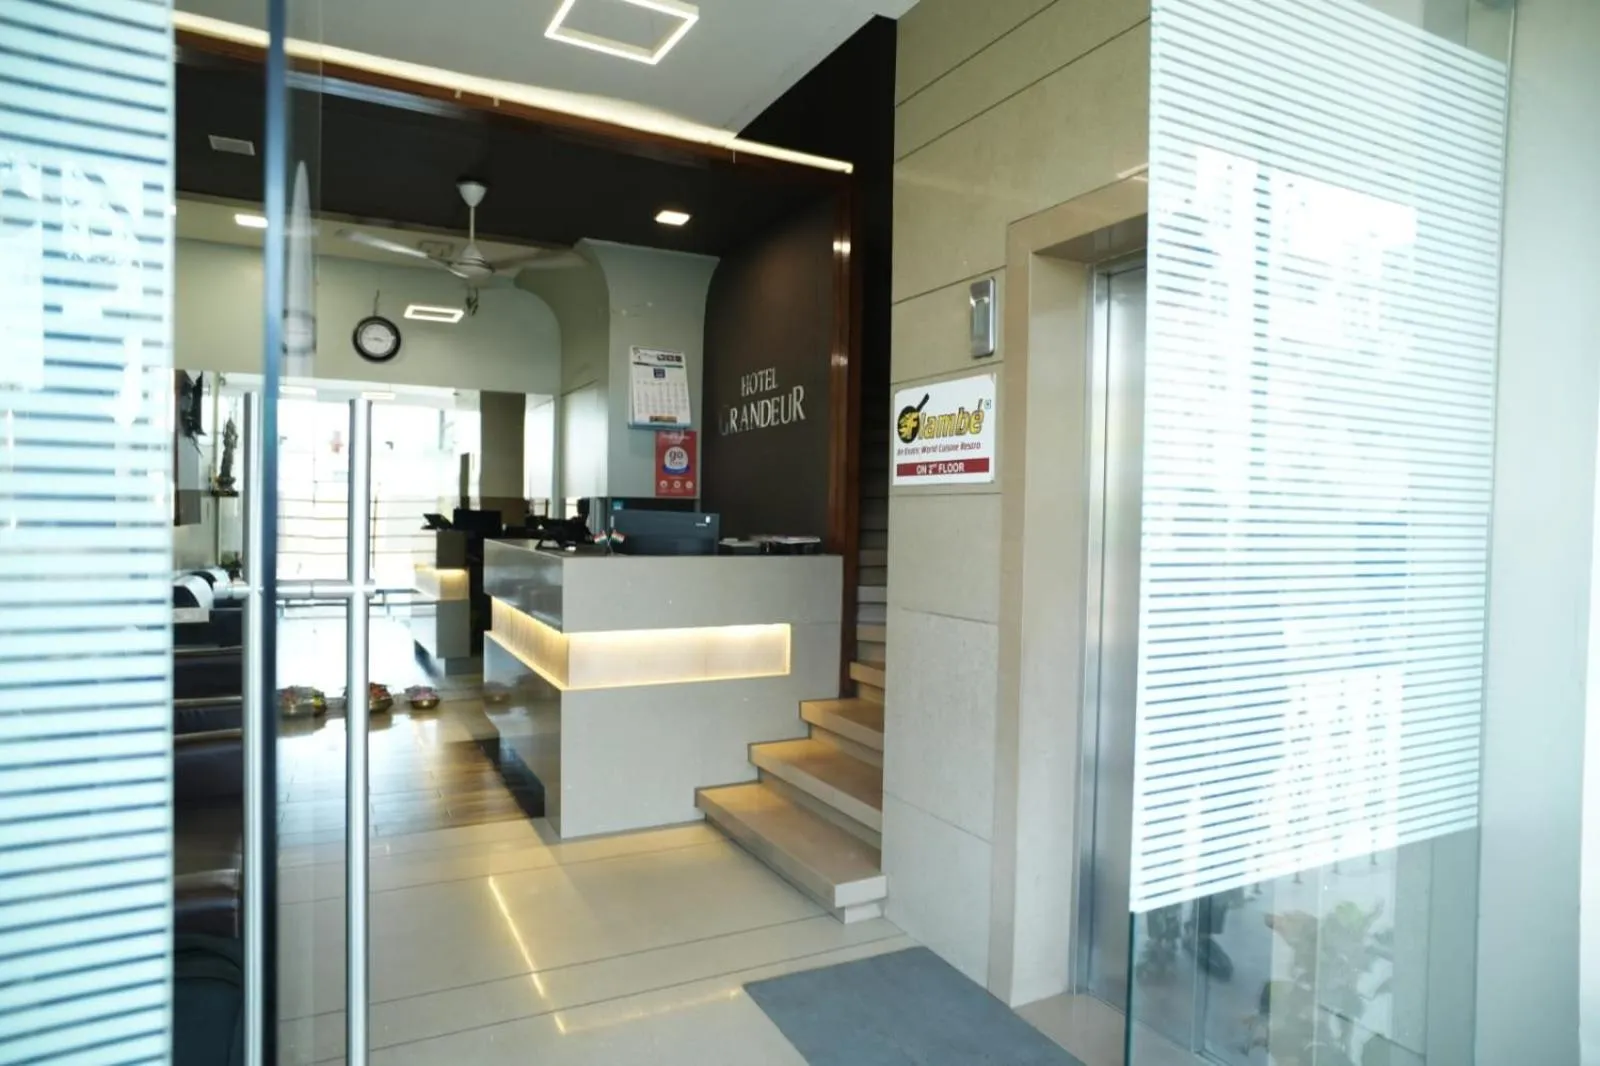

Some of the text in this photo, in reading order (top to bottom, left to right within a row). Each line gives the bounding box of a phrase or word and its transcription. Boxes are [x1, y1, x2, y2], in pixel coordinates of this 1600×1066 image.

[741, 367, 778, 397] HOTEL
[916, 464, 927, 475] ON
[938, 462, 965, 473] FLOOR
